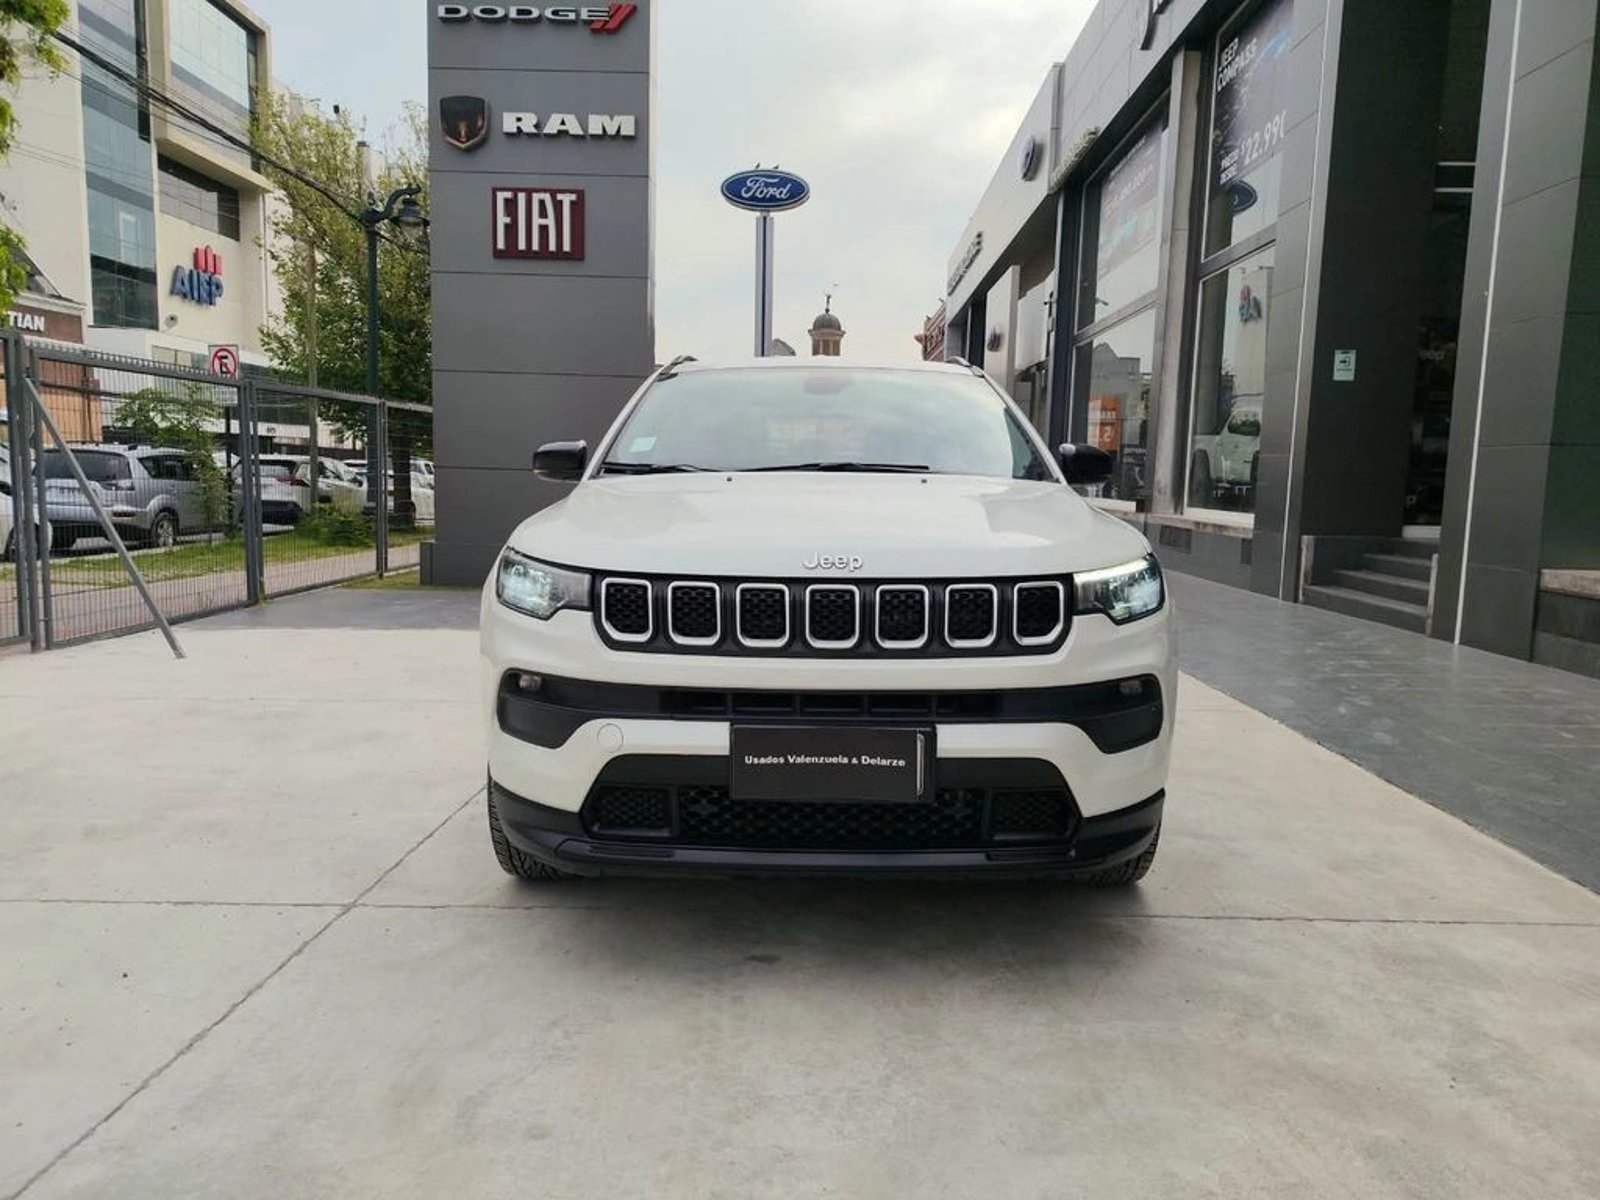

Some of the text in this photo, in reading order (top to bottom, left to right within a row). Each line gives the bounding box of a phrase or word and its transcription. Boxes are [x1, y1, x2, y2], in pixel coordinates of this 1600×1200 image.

[437, 4, 610, 21] DODGE
[1217, 38, 1257, 92] COMPASS
[1218, 37, 1239, 71] JEEP
[502, 112, 636, 137] RAM
[741, 175, 792, 199] Ford
[495, 190, 578, 253] FIAT
[801, 551, 863, 572] Jeep
[744, 754, 906, 767] Usados Valenzuela & Delarze
